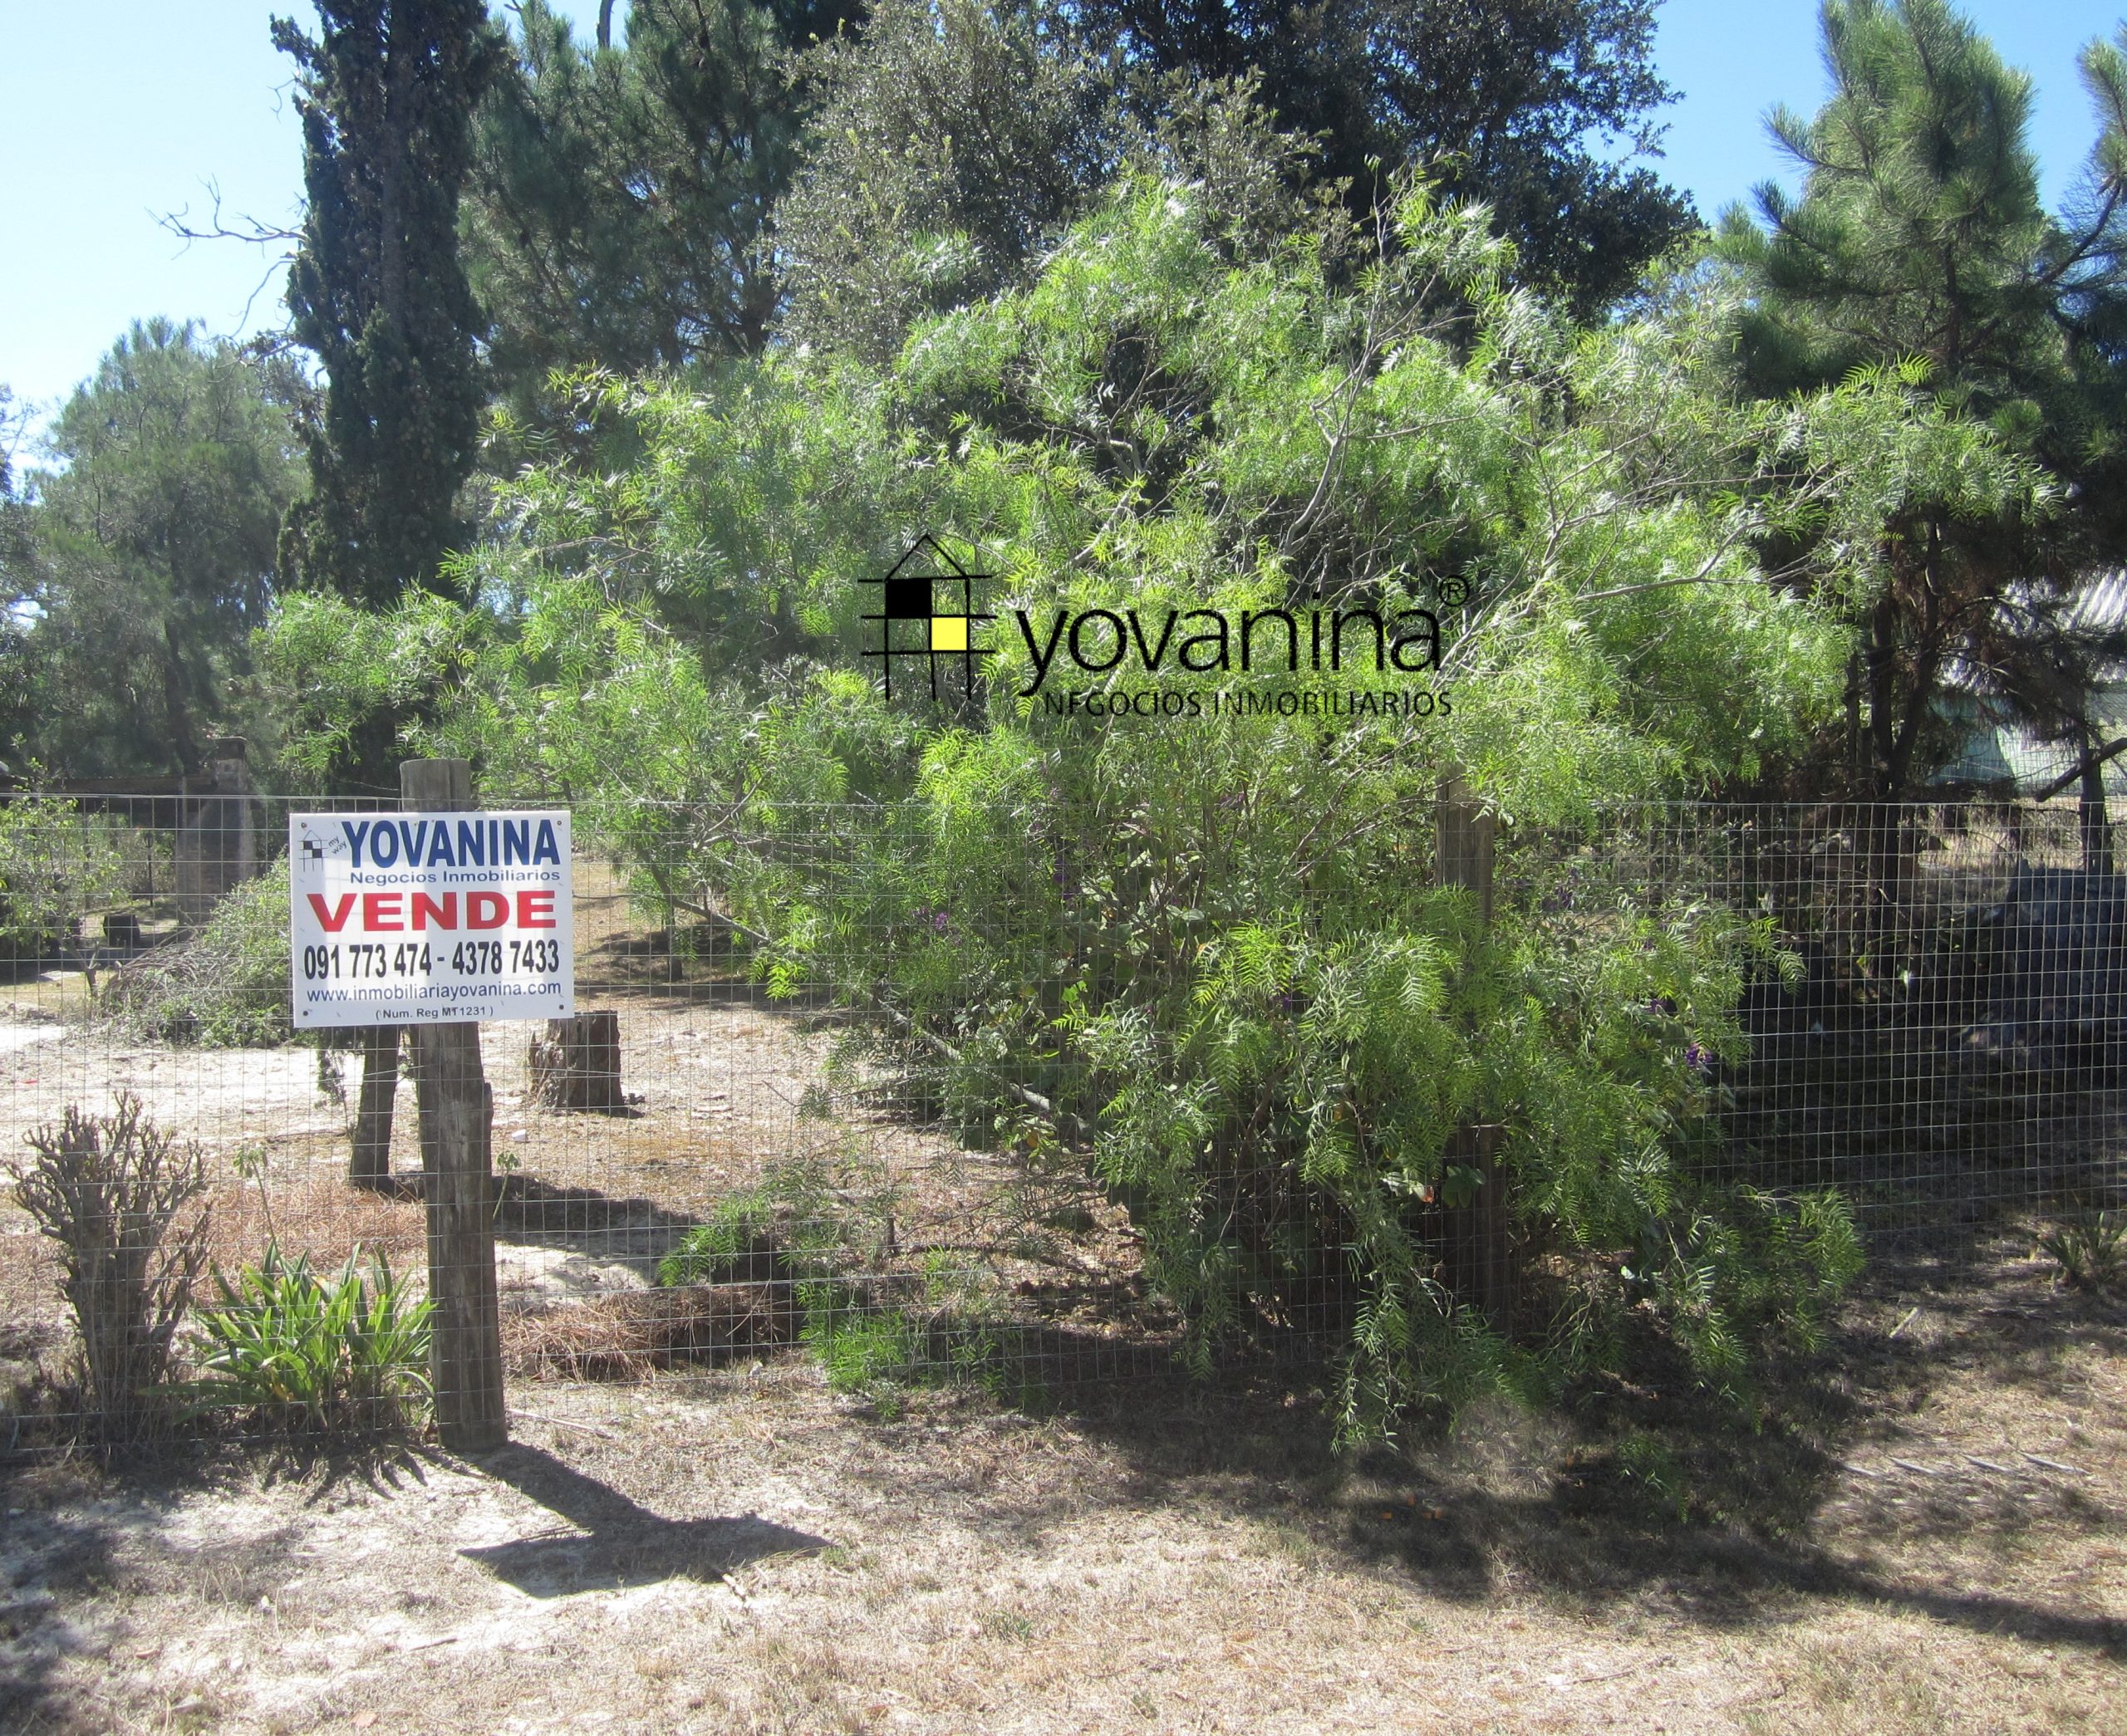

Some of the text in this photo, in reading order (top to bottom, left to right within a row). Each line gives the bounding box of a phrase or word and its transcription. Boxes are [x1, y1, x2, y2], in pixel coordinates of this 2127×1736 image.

[328, 836, 340, 847] my
[332, 840, 347, 855] way
[341, 819, 561, 868] YOVANINA
[350, 870, 561, 887] Negocios Inmobiliarios
[307, 890, 557, 933] VENDE
[304, 944, 340, 980] 091
[349, 944, 386, 978] 773
[394, 942, 432, 978] 474
[452, 940, 503, 975] 4378
[509, 939, 559, 973] 7433
[307, 980, 562, 1003] www.inmobiliariayovanina.com
[416, 1008, 439, 1019] Reg
